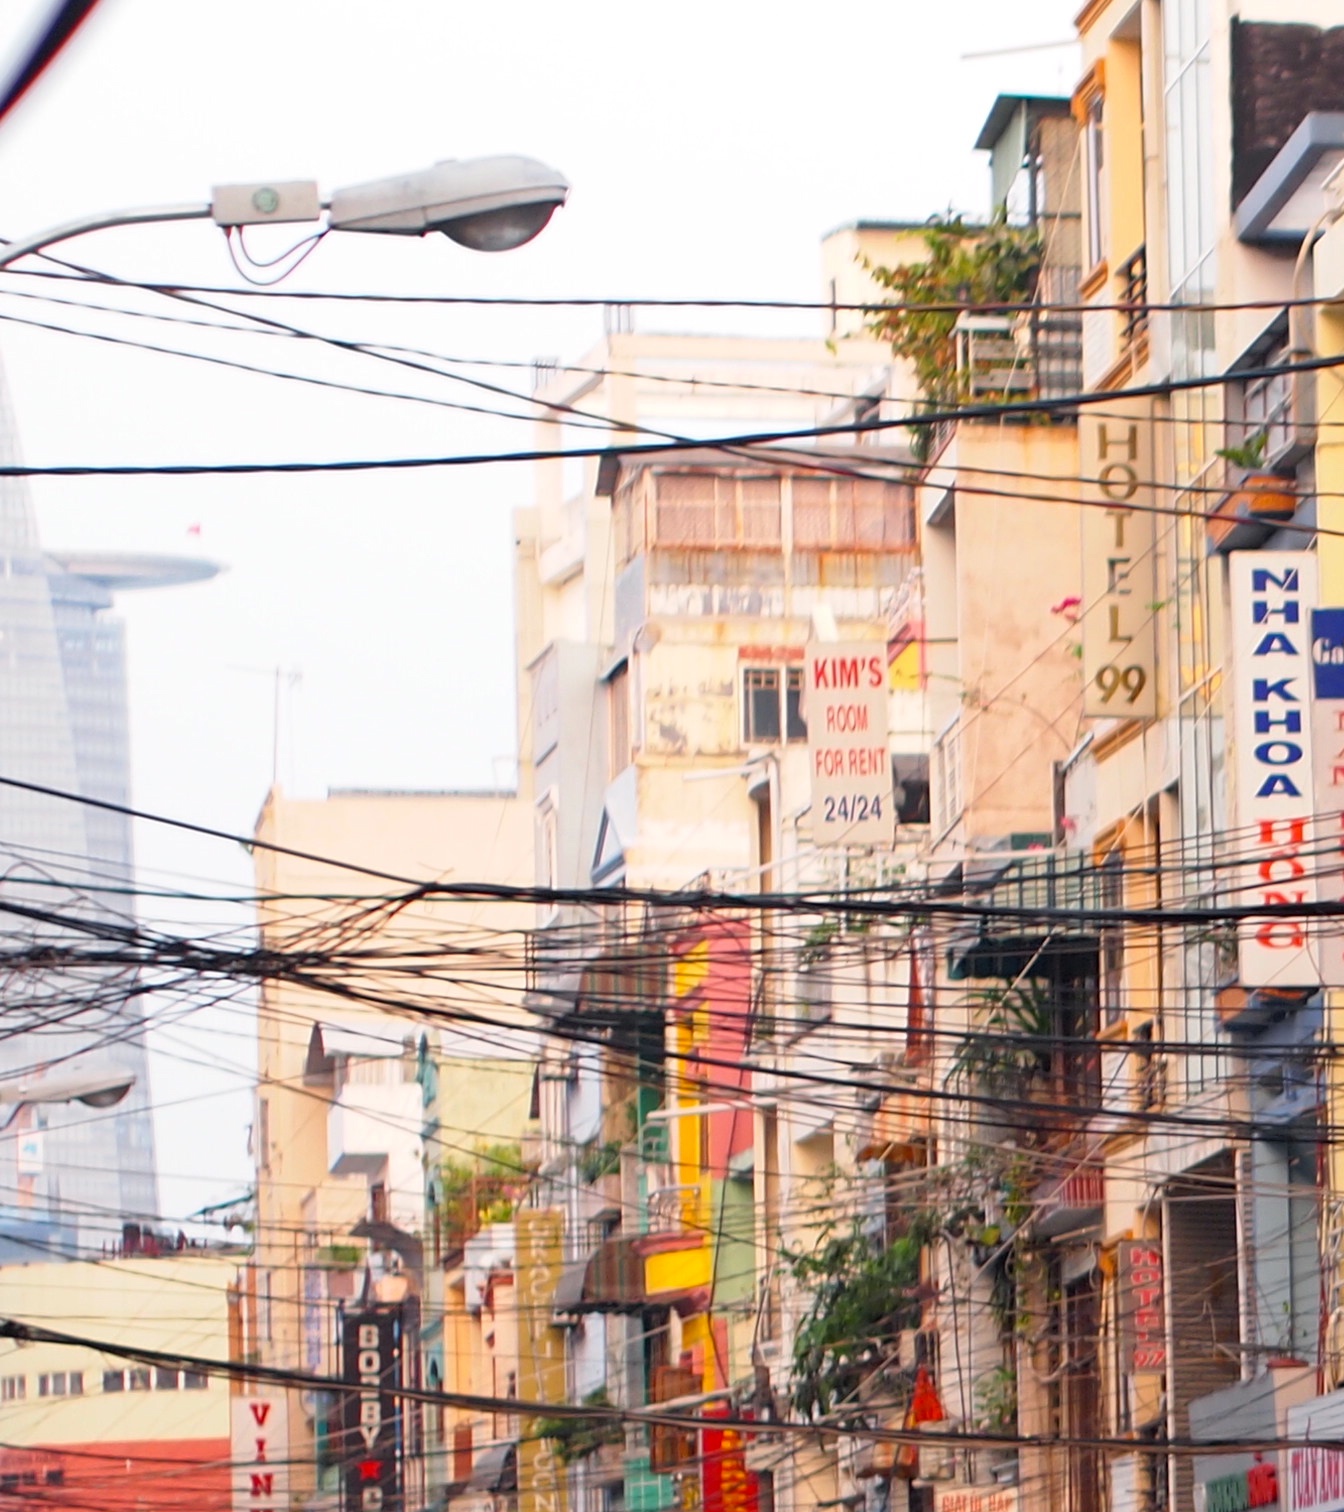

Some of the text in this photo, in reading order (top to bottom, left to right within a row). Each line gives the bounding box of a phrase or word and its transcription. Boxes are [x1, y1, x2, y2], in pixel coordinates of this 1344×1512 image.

[1099, 424, 1139, 642] HOTEL
[813, 656, 883, 689] KIM'S
[1097, 666, 1147, 703] 99
[826, 704, 868, 733] ROOM
[1251, 678, 1304, 798] KHOA
[815, 748, 887, 777] FOR RENT
[824, 794, 883, 823] 24/24
